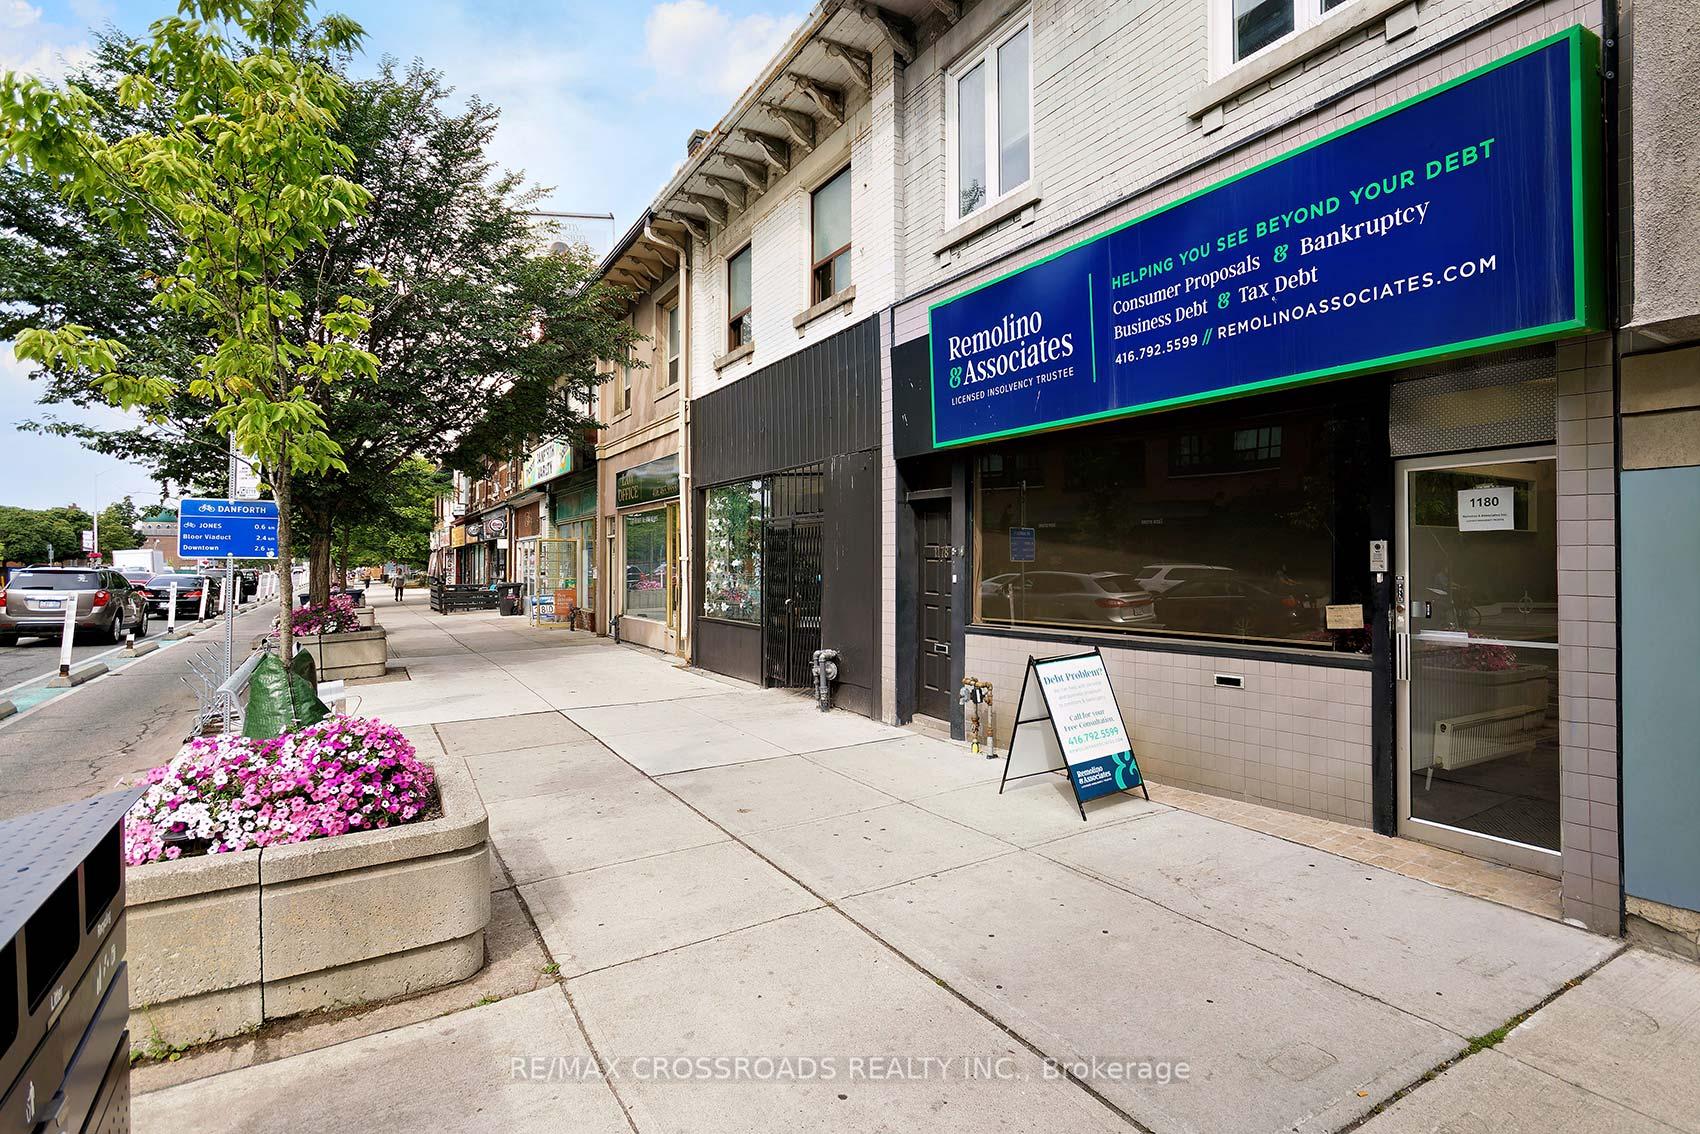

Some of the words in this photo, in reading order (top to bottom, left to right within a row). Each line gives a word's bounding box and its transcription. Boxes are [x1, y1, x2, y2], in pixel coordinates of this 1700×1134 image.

[1112, 257, 1174, 290] HELPING
[1179, 242, 1211, 266] YOU
[1217, 228, 1249, 252] SEE
[1256, 196, 1340, 238] BEYOND
[1349, 170, 1415, 205] YOUR
[1426, 137, 1495, 180] DEBT
[1112, 282, 1181, 315] Consumer
[1185, 254, 1261, 293] Proposals
[1273, 244, 1289, 263] &
[1300, 201, 1430, 256] Bankruptcy
[1113, 312, 1172, 340] Business
[1175, 299, 1209, 323] Debt
[1217, 291, 1231, 309] &
[1238, 282, 1270, 303] Tax
[1274, 265, 1319, 294] Debt
[1115, 334, 1198, 365] 416.792.5599
[1217, 254, 1497, 339] REMOLINOASSOCIATES.COM
[948, 311, 1043, 361] Remolino
[951, 390, 986, 406] LICENSED
[987, 377, 1034, 398] INSOLVENCY
[1036, 366, 1075, 385] TRUSTEE
[617, 485, 639, 502] OFFICE
[1470, 496, 1499, 508] 1180
[217, 505, 267, 514] DANFORTH
[199, 521, 222, 529] JONES
[254, 523, 266, 531] 0.6
[1043, 674, 1064, 686] Debt
[1065, 667, 1103, 681] Problem?
[1068, 711, 1082, 721] Call
[1082, 710, 1091, 719] for
[1091, 709, 1105, 717] your
[1063, 723, 1077, 732] Free
[1068, 726, 1119, 746] 416.792.5599
[1076, 765, 1104, 777] Remolino
